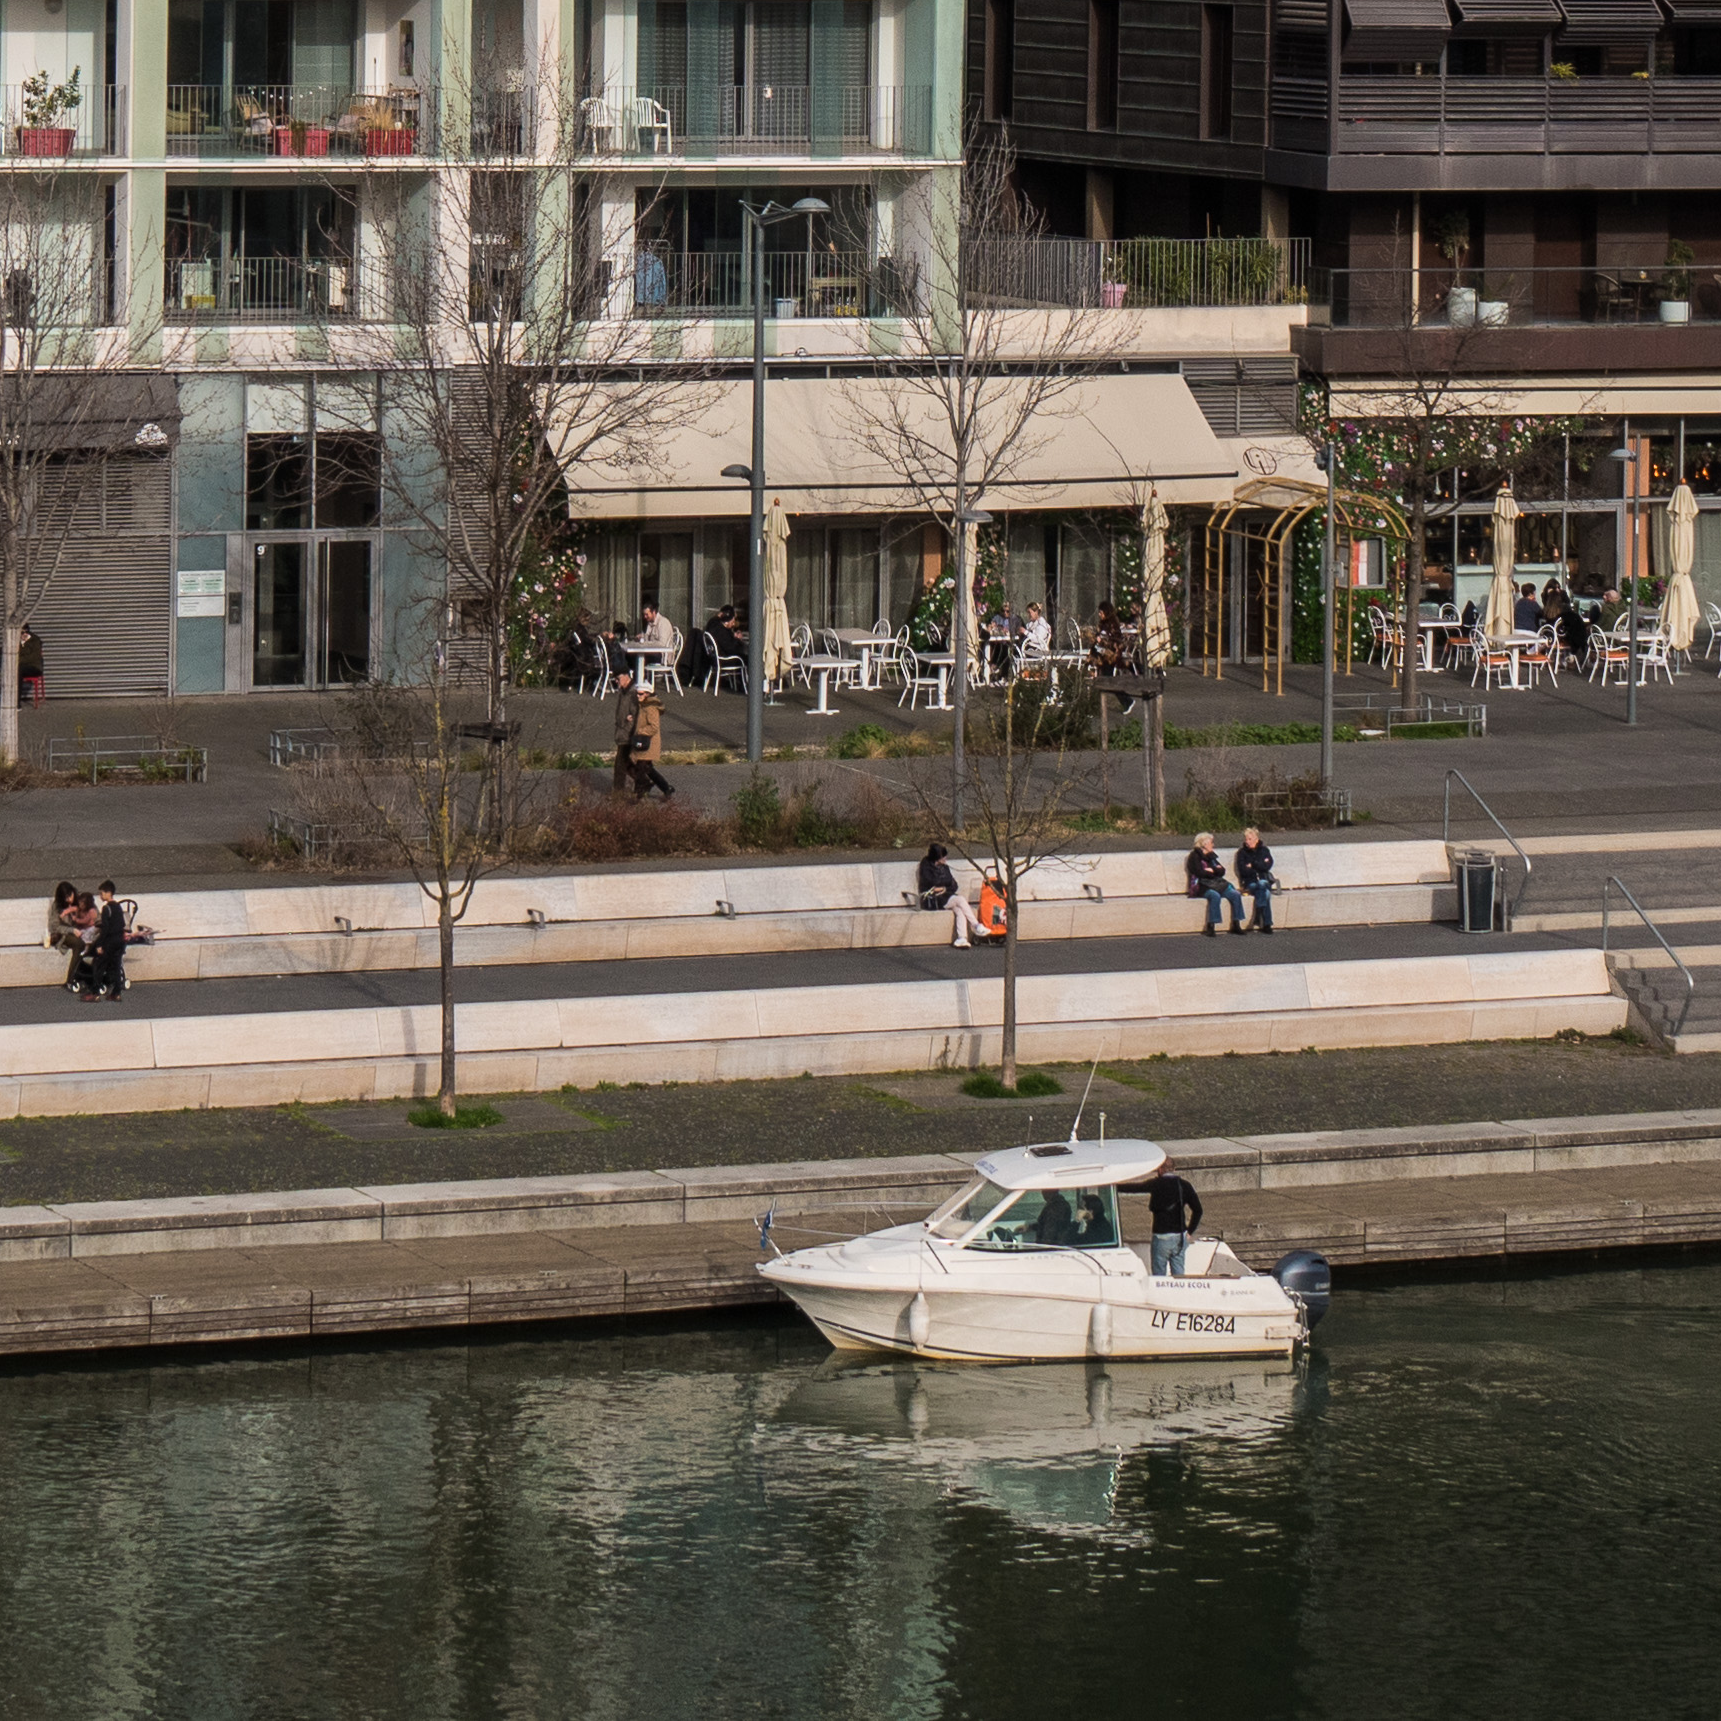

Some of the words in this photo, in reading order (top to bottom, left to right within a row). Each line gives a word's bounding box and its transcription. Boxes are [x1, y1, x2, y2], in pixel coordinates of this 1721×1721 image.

[257, 545, 266, 556] 9
[1155, 1280, 1186, 1289] BATEAU
[1187, 1281, 1211, 1290] ECOLE
[1151, 1309, 1170, 1330] LY
[1176, 1312, 1236, 1334] E16284
